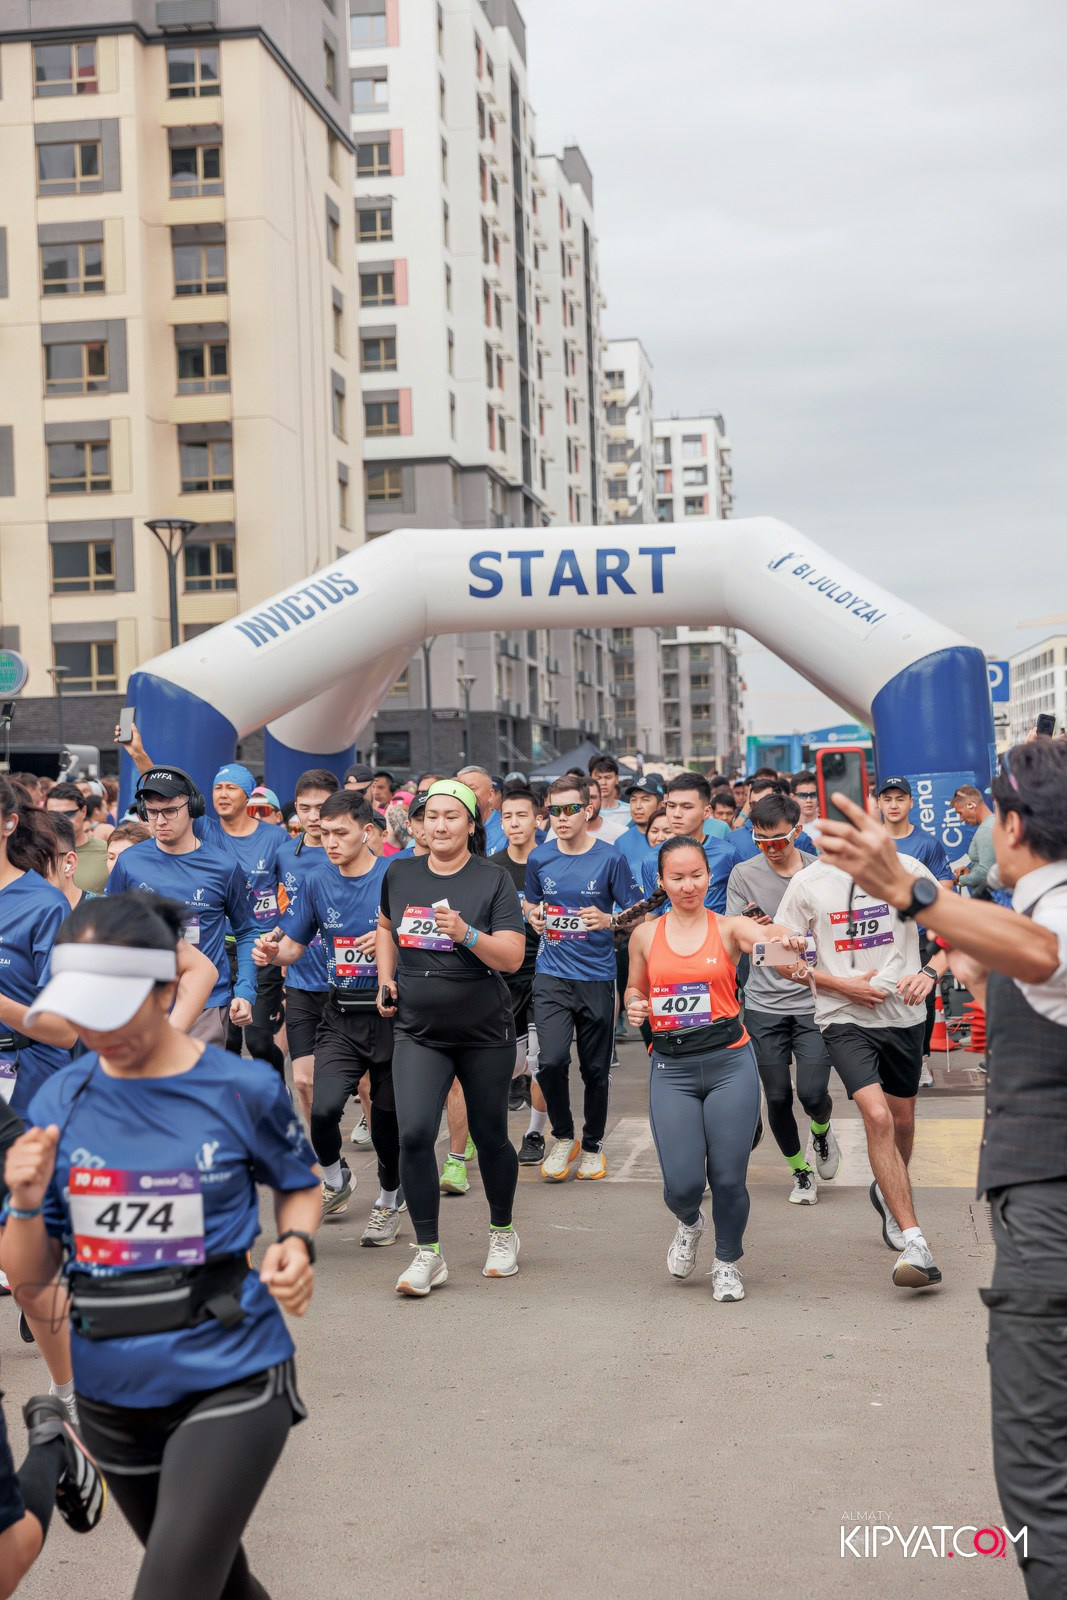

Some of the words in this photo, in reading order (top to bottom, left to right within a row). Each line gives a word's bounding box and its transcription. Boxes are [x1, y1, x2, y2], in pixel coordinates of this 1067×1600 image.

[469, 547, 676, 598] START
[792, 563, 816, 580] BI
[808, 576, 887, 624] JULDYZAI
[234, 572, 359, 647] INVICTUS
[150, 772, 172, 781] NYFA
[917, 780, 936, 836] rena
[552, 917, 579, 930] 436
[846, 919, 879, 937] 419
[661, 995, 701, 1013] 407
[74, 1172, 91, 1187] 10
[92, 1175, 112, 1187] KM
[95, 1201, 173, 1233] 474
